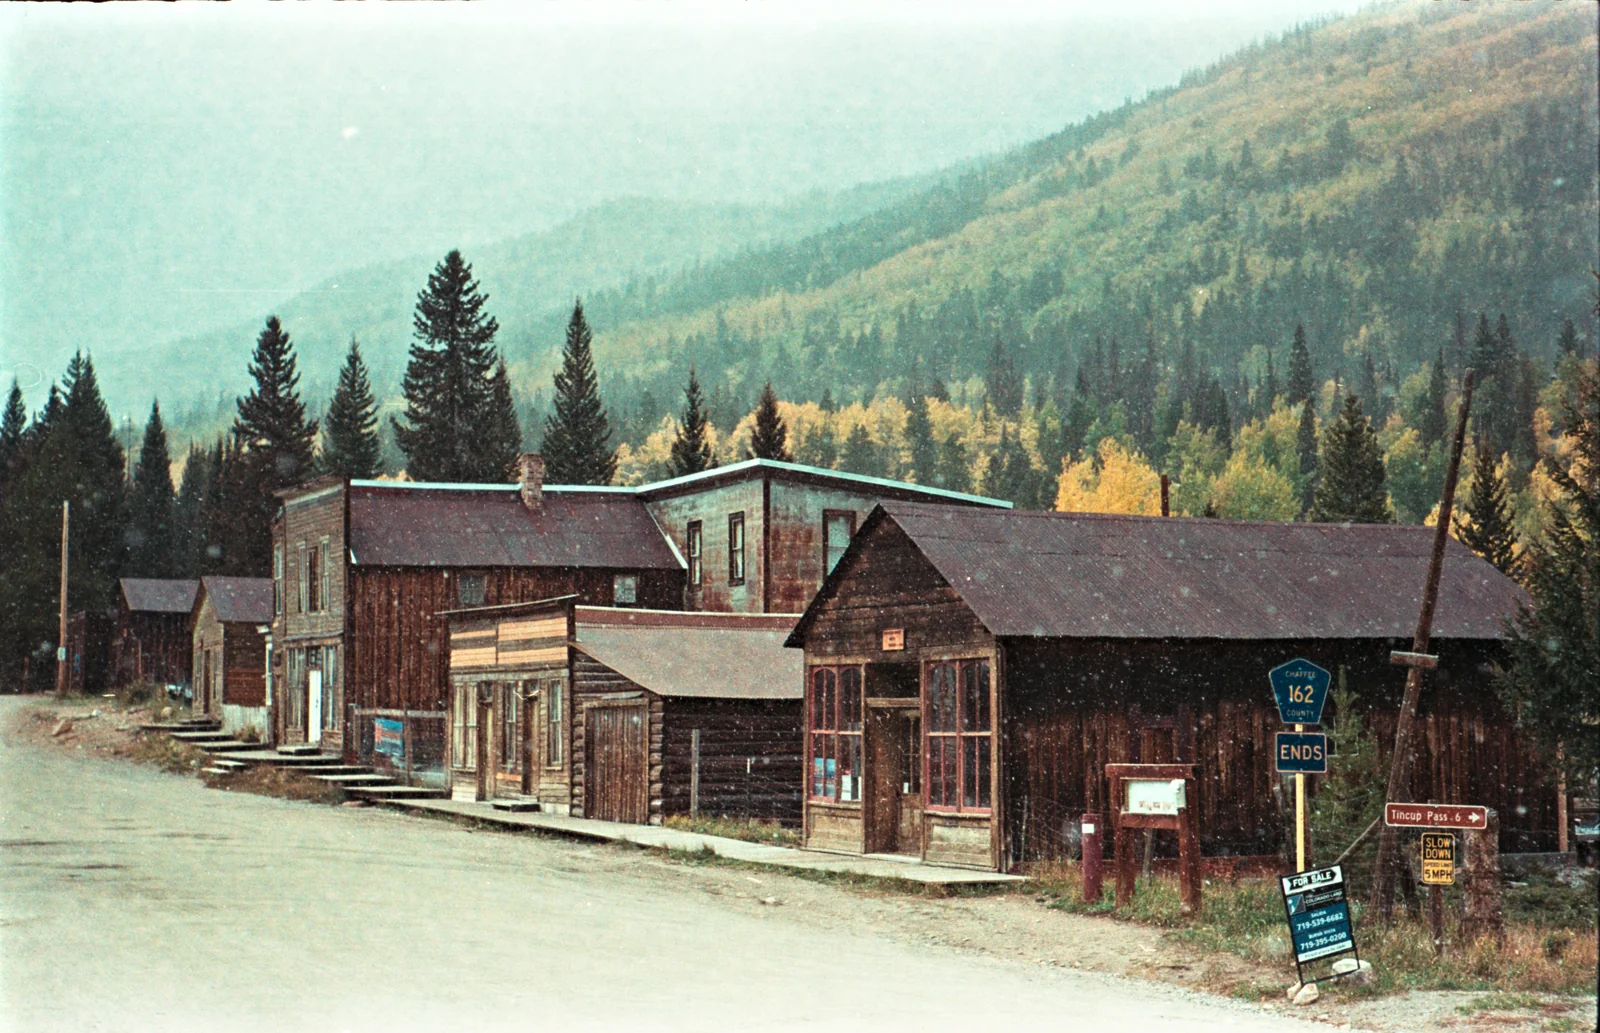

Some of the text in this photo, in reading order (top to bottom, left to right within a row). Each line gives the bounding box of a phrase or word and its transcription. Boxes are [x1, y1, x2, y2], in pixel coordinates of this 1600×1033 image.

[1285, 670, 1316, 678] CHAFFEE
[1288, 685, 1314, 703] 162
[1286, 709, 1315, 717] COUNTY
[1280, 744, 1323, 761] ENDS
[1391, 809, 1461, 822] Tincup Pass 6
[1425, 837, 1450, 848] SLOW
[1425, 848, 1451, 859] DOWN
[1292, 871, 1332, 887] FOR SALE
[1296, 912, 1344, 931] 719-539-6682
[1300, 931, 1347, 950] 719-395-0200
